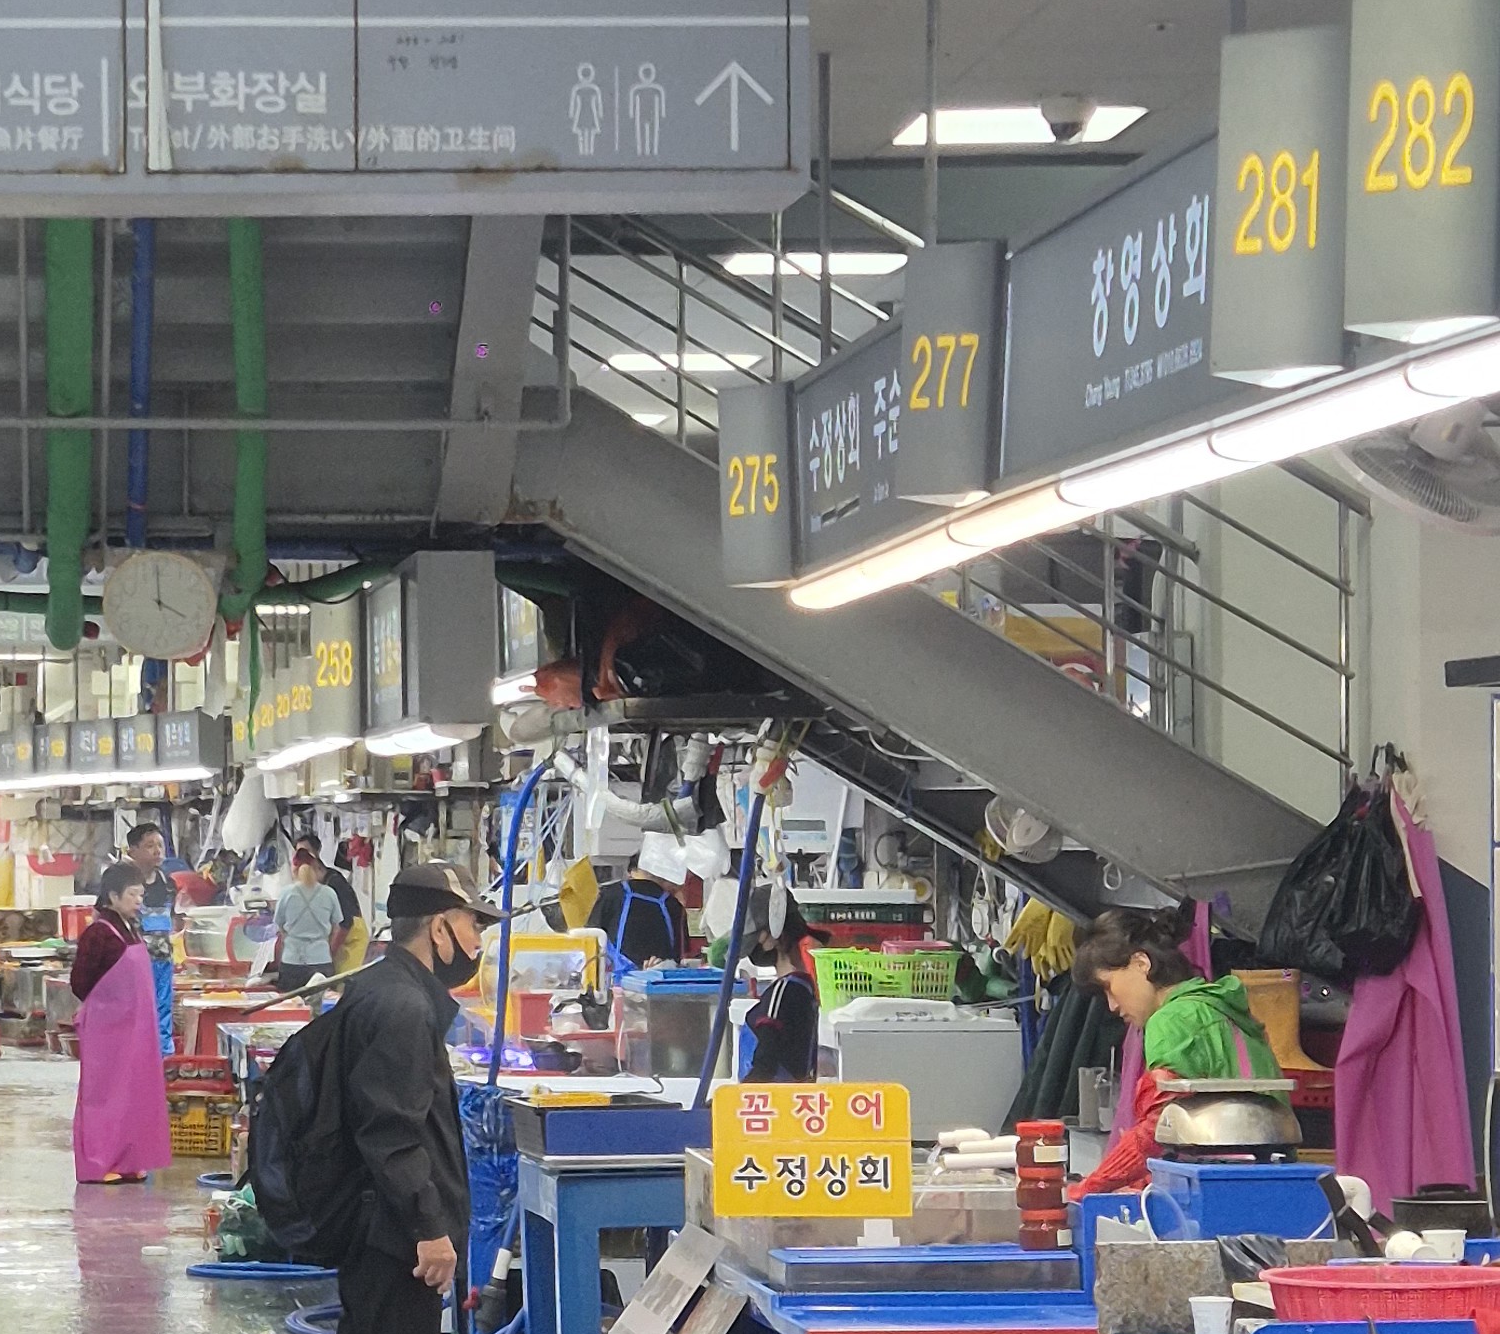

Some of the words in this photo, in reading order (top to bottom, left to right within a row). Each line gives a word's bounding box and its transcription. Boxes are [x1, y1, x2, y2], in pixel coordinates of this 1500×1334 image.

[1365, 72, 1475, 193] 282
[1234, 149, 1320, 256] 281
[1090, 194, 1210, 357] 창영상회
[909, 333, 980, 410] 277
[728, 454, 780, 517] 275
[808, 391, 861, 493] 수정상회
[315, 640, 353, 687] 258
[733, 1154, 890, 1197] 수정상회
